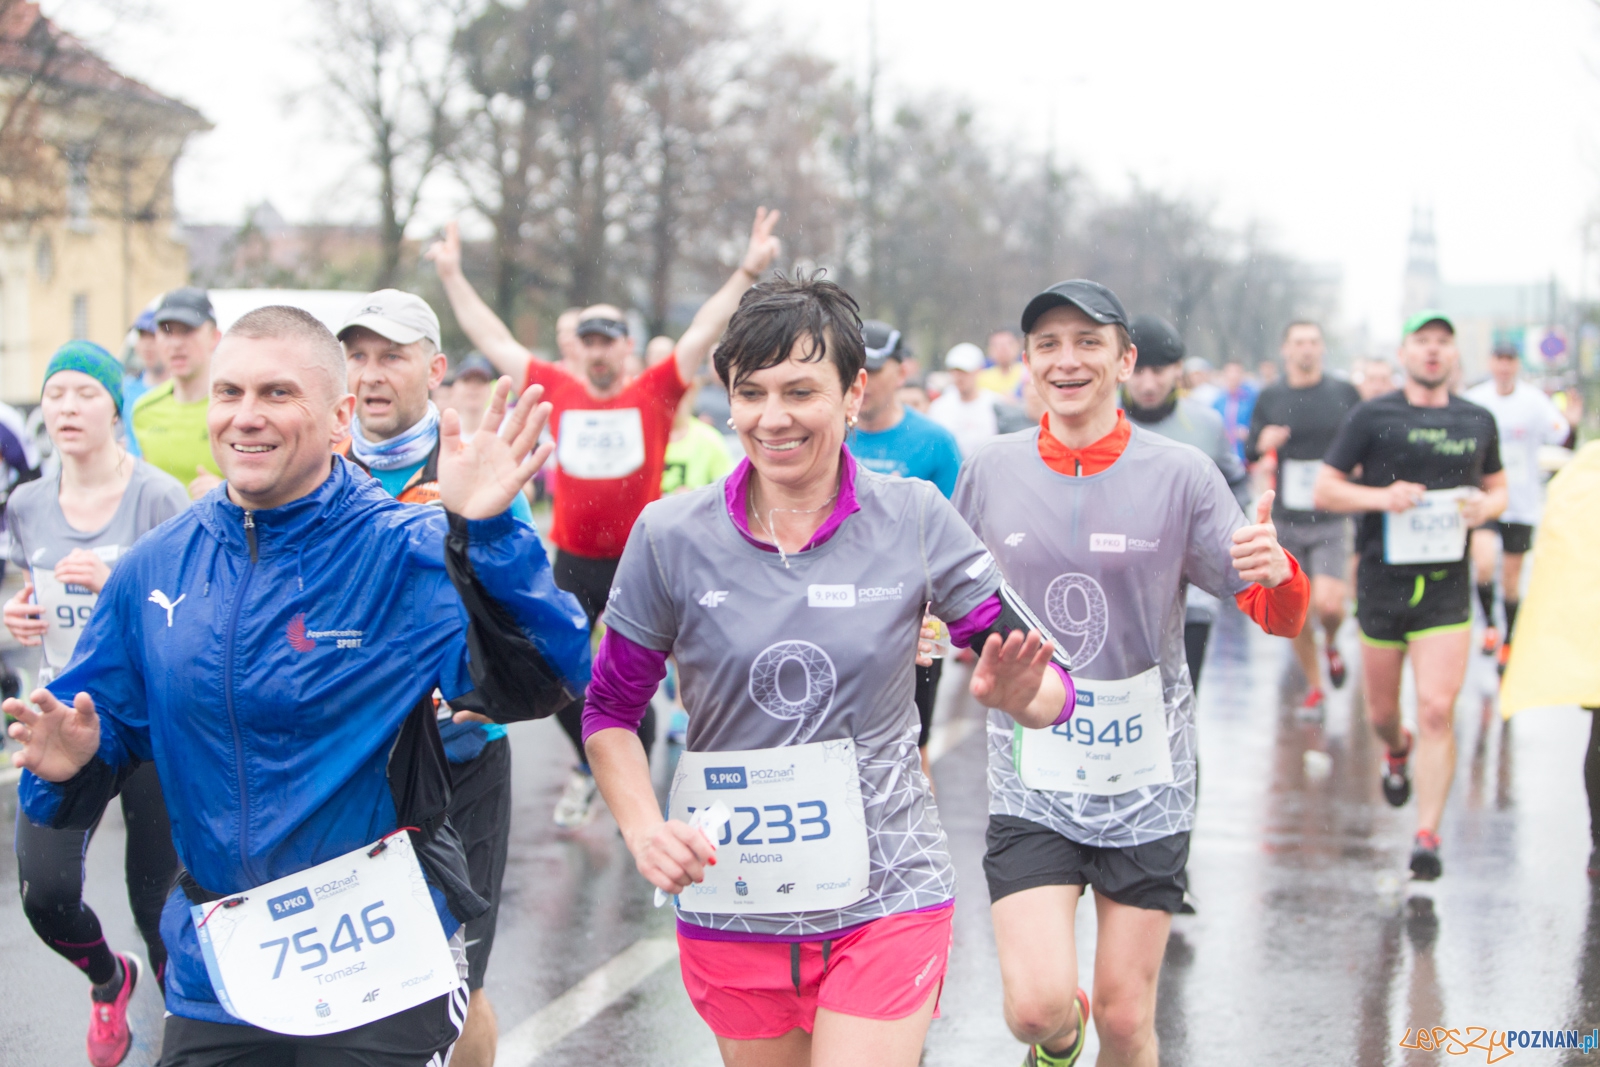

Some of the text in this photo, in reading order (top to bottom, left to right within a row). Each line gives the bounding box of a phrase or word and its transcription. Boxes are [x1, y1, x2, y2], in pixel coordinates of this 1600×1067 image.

[1004, 533, 1026, 547] 4F
[698, 590, 730, 607] 4F
[815, 590, 848, 601] 9.PKO
[336, 638, 363, 649] SPORT
[1051, 713, 1143, 747] 4946
[709, 772, 742, 785] 9.PKO
[739, 853, 783, 864] Aldona
[776, 882, 796, 894] 4F
[273, 894, 307, 914] 9.PKO
[259, 900, 396, 980] 7546
[313, 961, 368, 986] Tomasz
[362, 988, 381, 1003] 4F
